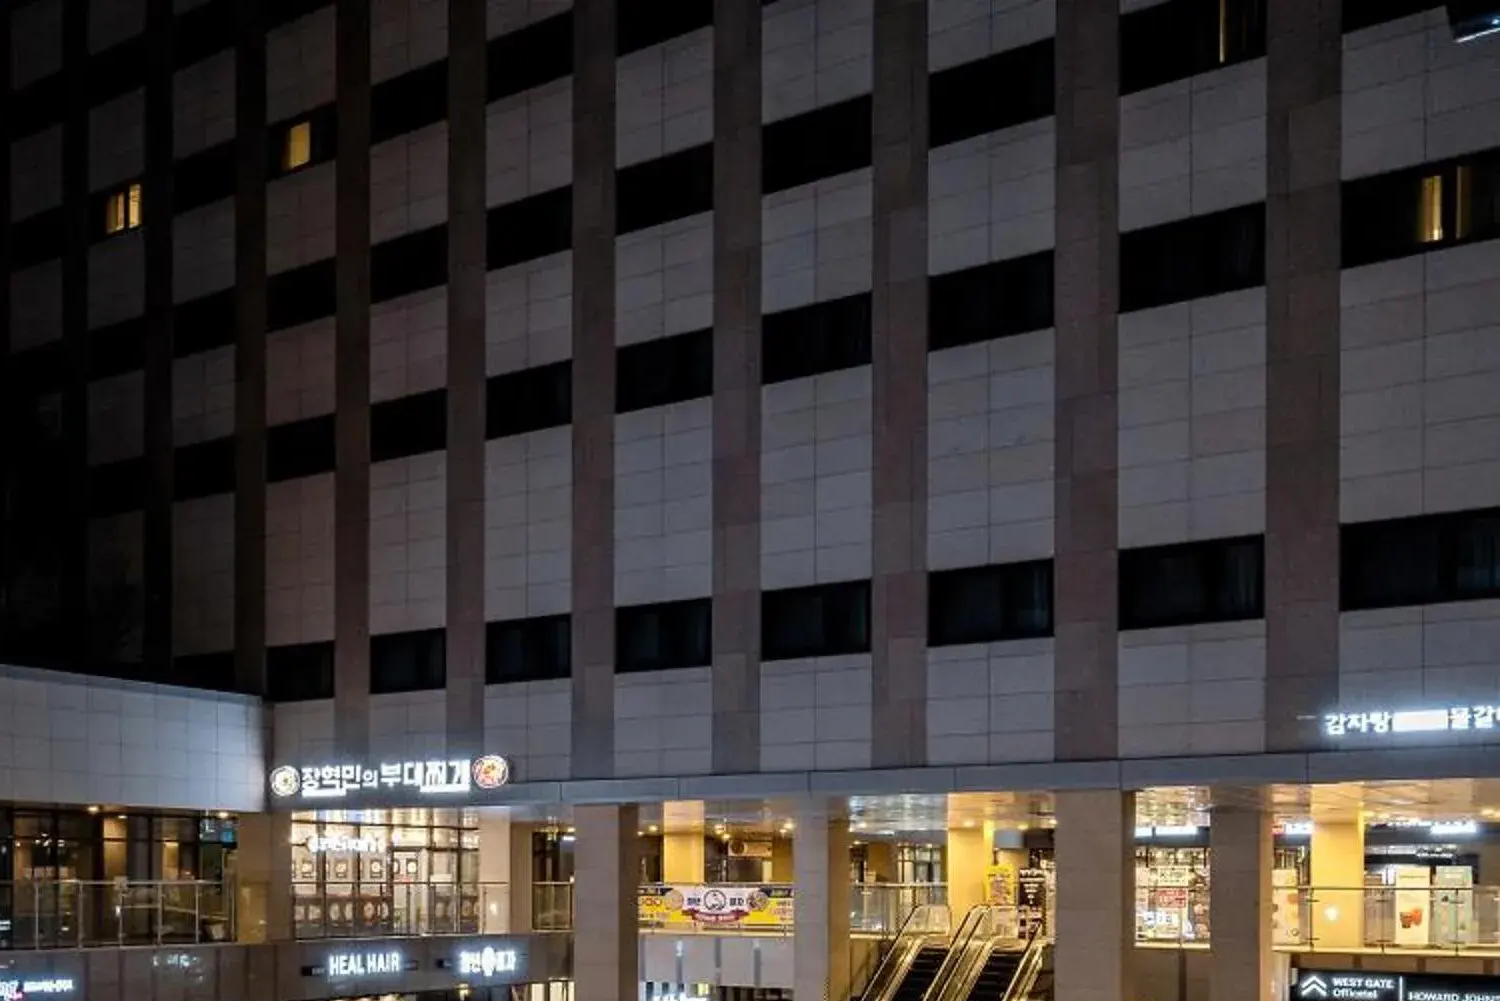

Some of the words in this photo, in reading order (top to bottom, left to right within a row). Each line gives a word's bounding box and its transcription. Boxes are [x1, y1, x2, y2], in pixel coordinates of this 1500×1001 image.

[329, 954, 364, 976] HEAL
[366, 951, 400, 973] HAIR
[1332, 977, 1362, 988] WEST
[1365, 977, 1394, 990] GATE
